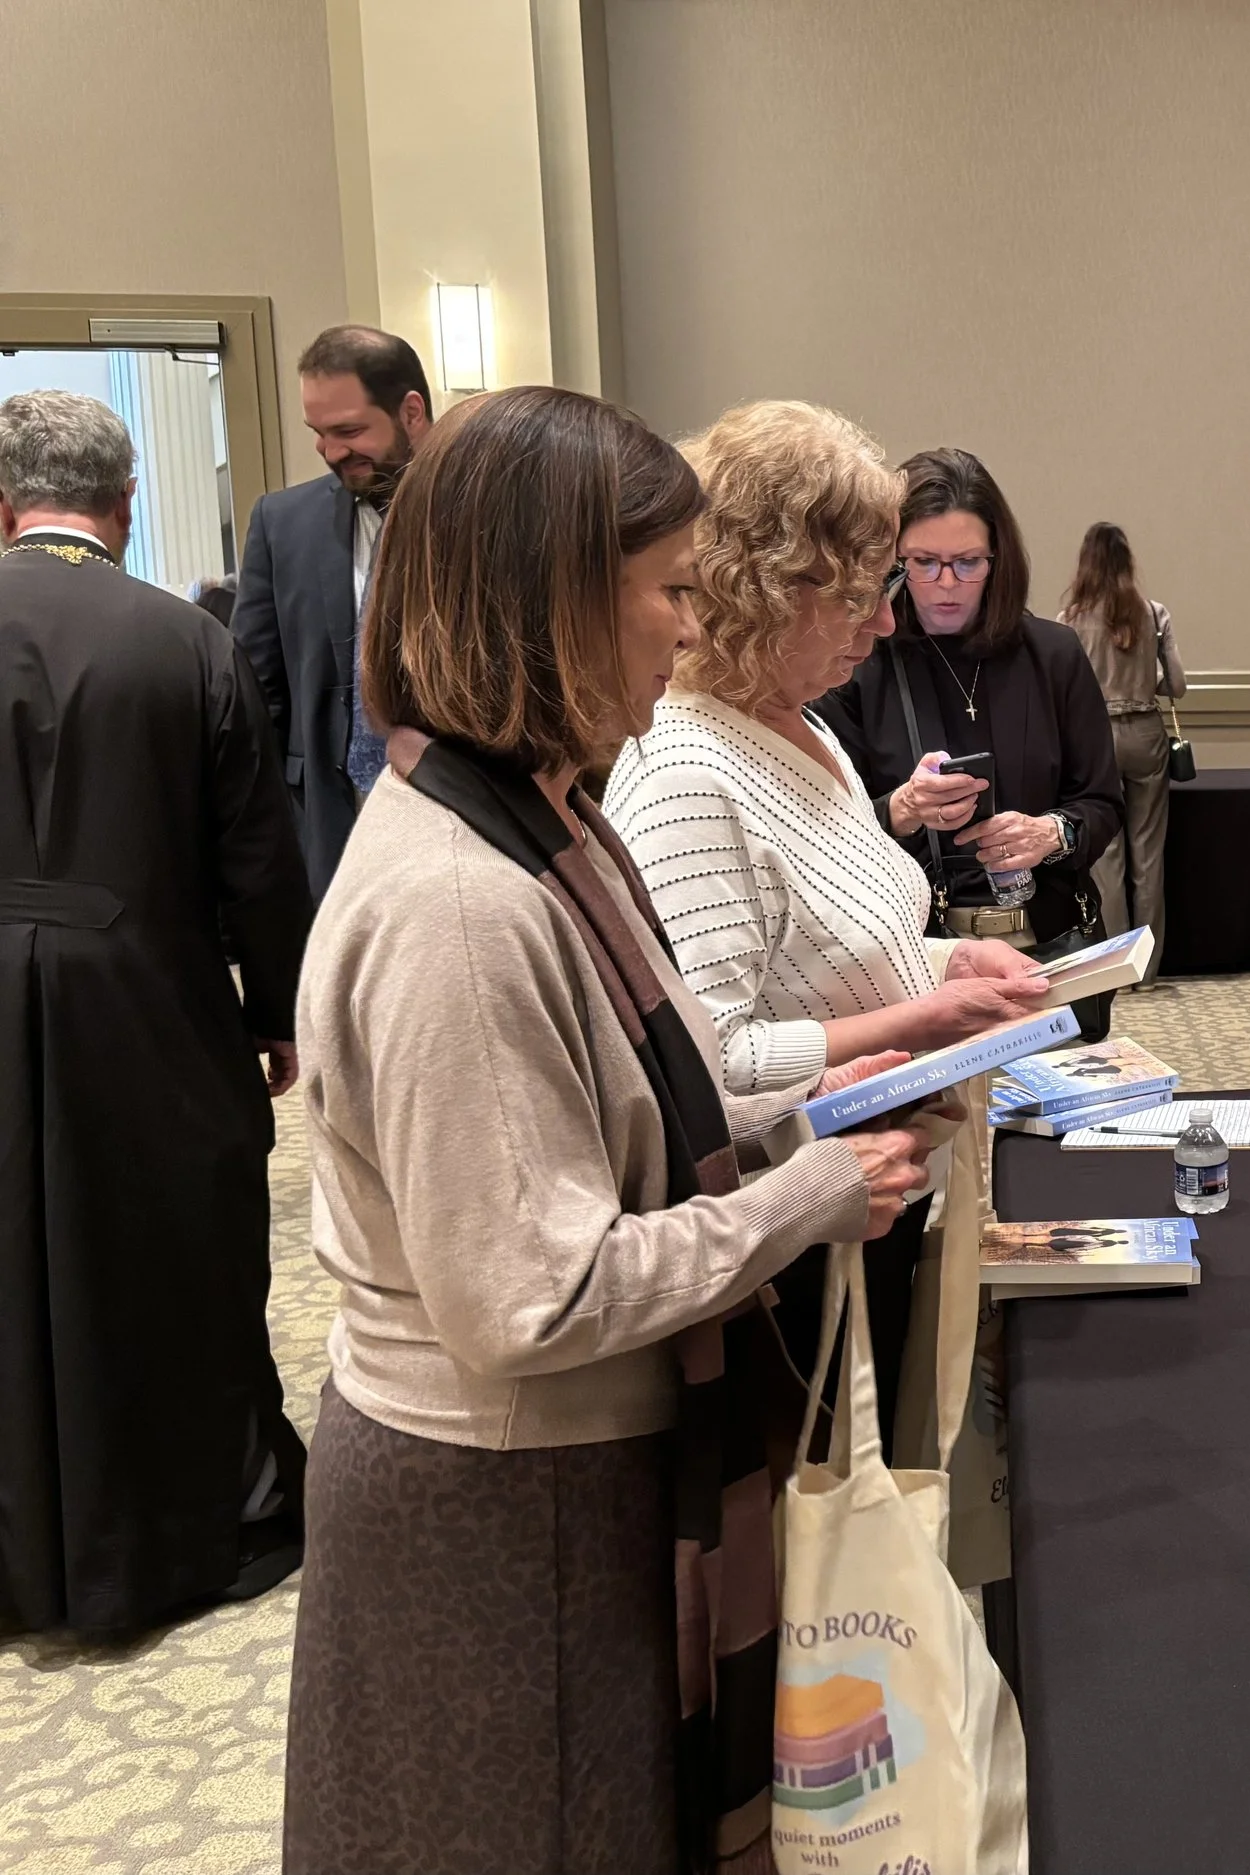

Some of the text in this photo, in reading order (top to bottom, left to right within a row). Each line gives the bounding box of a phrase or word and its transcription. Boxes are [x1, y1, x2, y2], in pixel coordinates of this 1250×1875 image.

[831, 1099, 868, 1118] Under
[870, 1093, 884, 1104] an
[887, 1076, 926, 1098] African
[927, 1068, 948, 1082] Sky
[954, 1053, 984, 1071] ELENE
[1053, 1099, 1071, 1109] Under
[1142, 1220, 1164, 1260] African Sky
[1161, 1221, 1181, 1255] Under an
[822, 1610, 918, 1650] BOOKS
[772, 1812, 902, 1847] quiet moments
[800, 1849, 840, 1868] with
